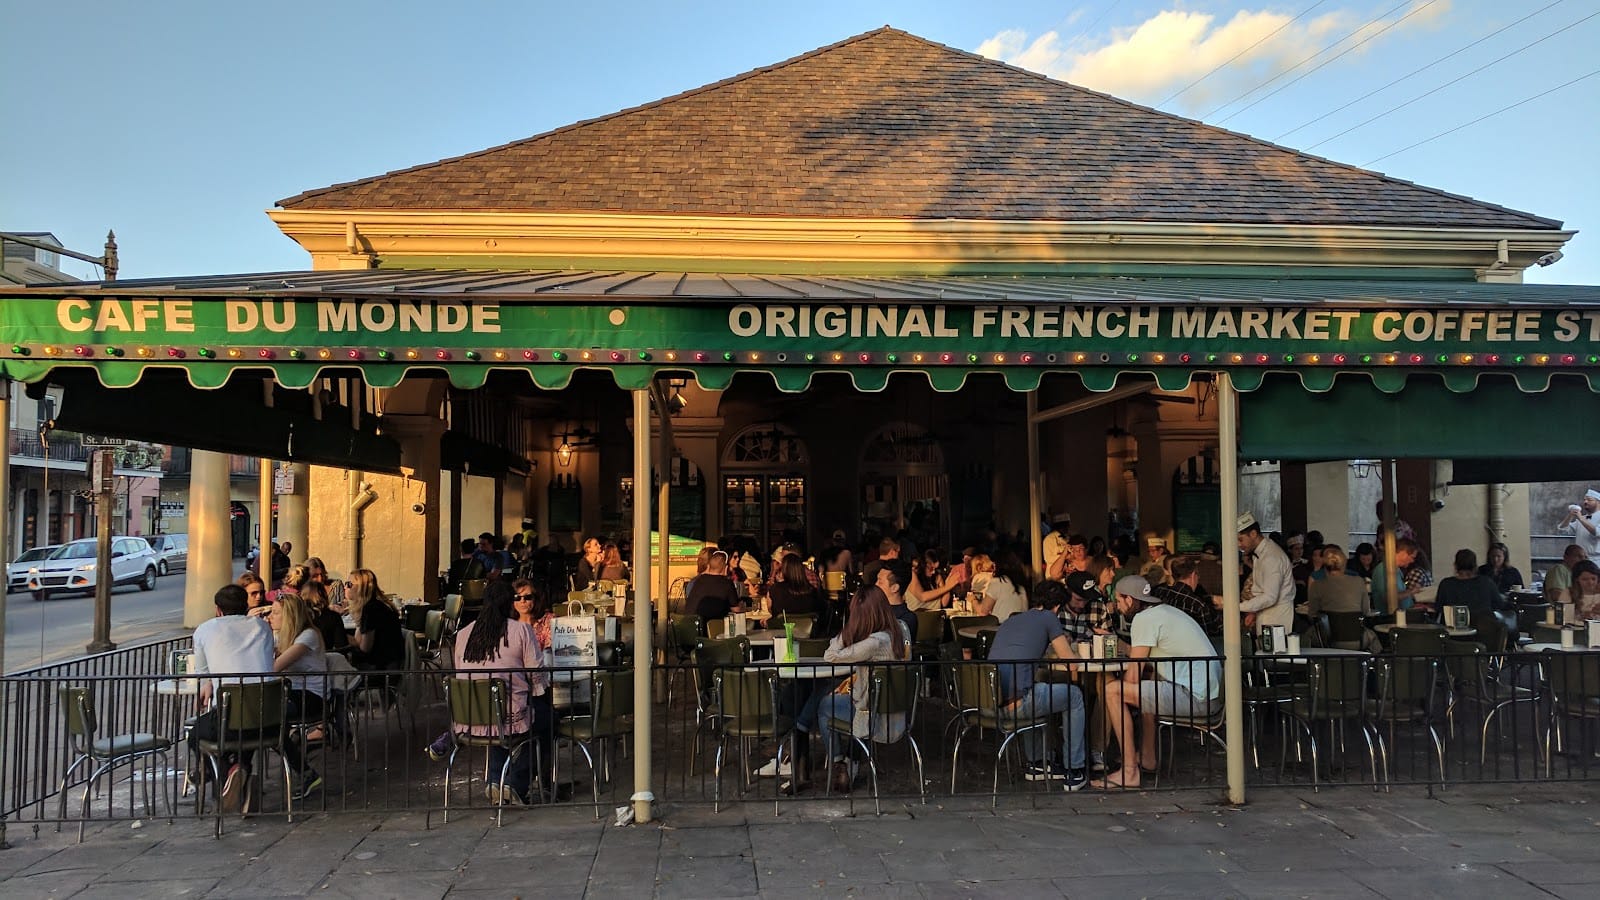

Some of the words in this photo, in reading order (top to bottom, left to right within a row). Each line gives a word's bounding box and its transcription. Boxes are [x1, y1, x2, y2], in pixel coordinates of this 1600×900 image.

[57, 297, 195, 332] CAFE
[225, 298, 297, 333] DU
[317, 298, 501, 333] MONDE
[728, 304, 959, 338] ORIGINAL
[972, 306, 1160, 339] FRENCH
[1171, 307, 1360, 340] MARKET
[1372, 311, 1541, 343] COFFEE
[102, 436, 122, 445] Ann
